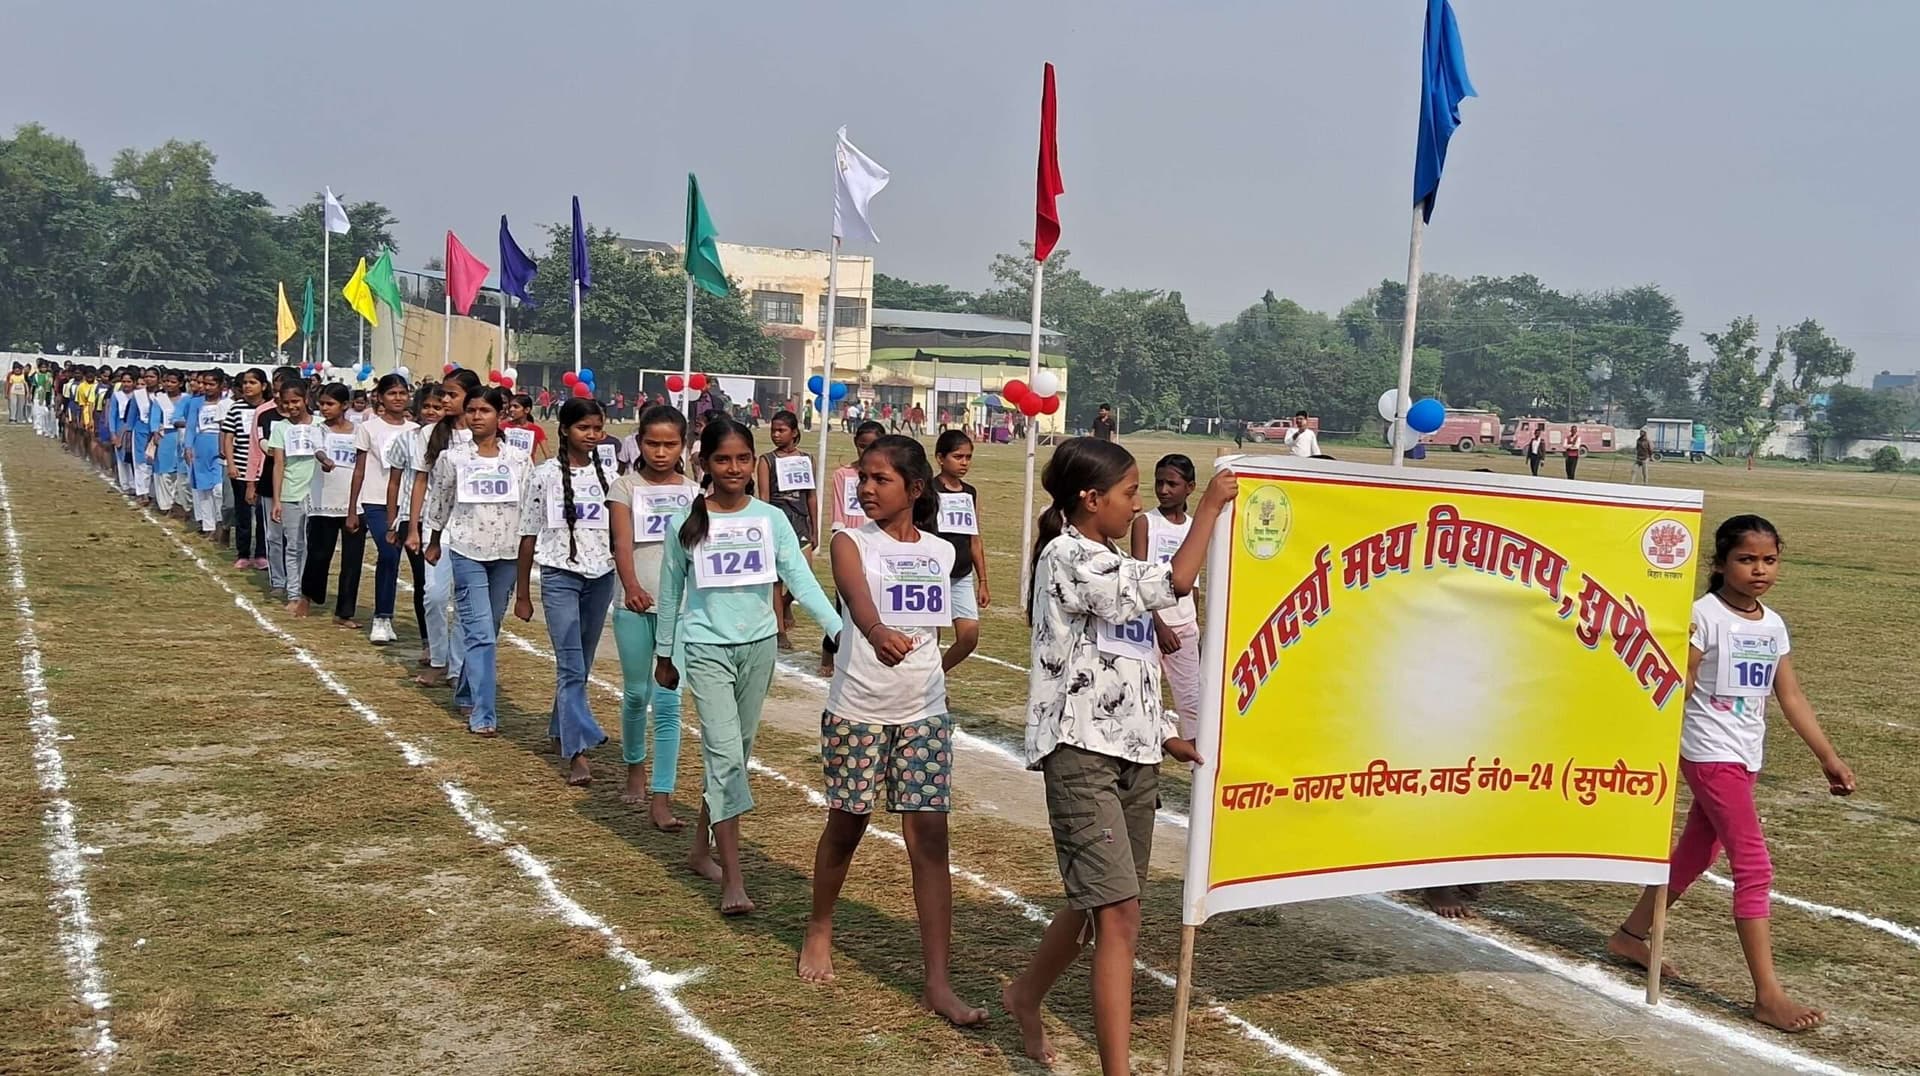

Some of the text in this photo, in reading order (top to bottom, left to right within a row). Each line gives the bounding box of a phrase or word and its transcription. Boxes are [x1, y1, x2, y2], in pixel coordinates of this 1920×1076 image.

[333, 450, 356, 464] 173
[468, 480, 509, 495] 130
[785, 472, 810, 484] 159
[946, 511, 972, 526] 176
[706, 550, 763, 575] 124
[886, 584, 943, 613] 158
[1231, 543, 1332, 714] आदर्श
[1341, 522, 1418, 589] मध्य
[1734, 661, 1773, 687] 160
[1292, 773, 1348, 803] नगर
[1561, 756, 1668, 806] (सुपौल)
